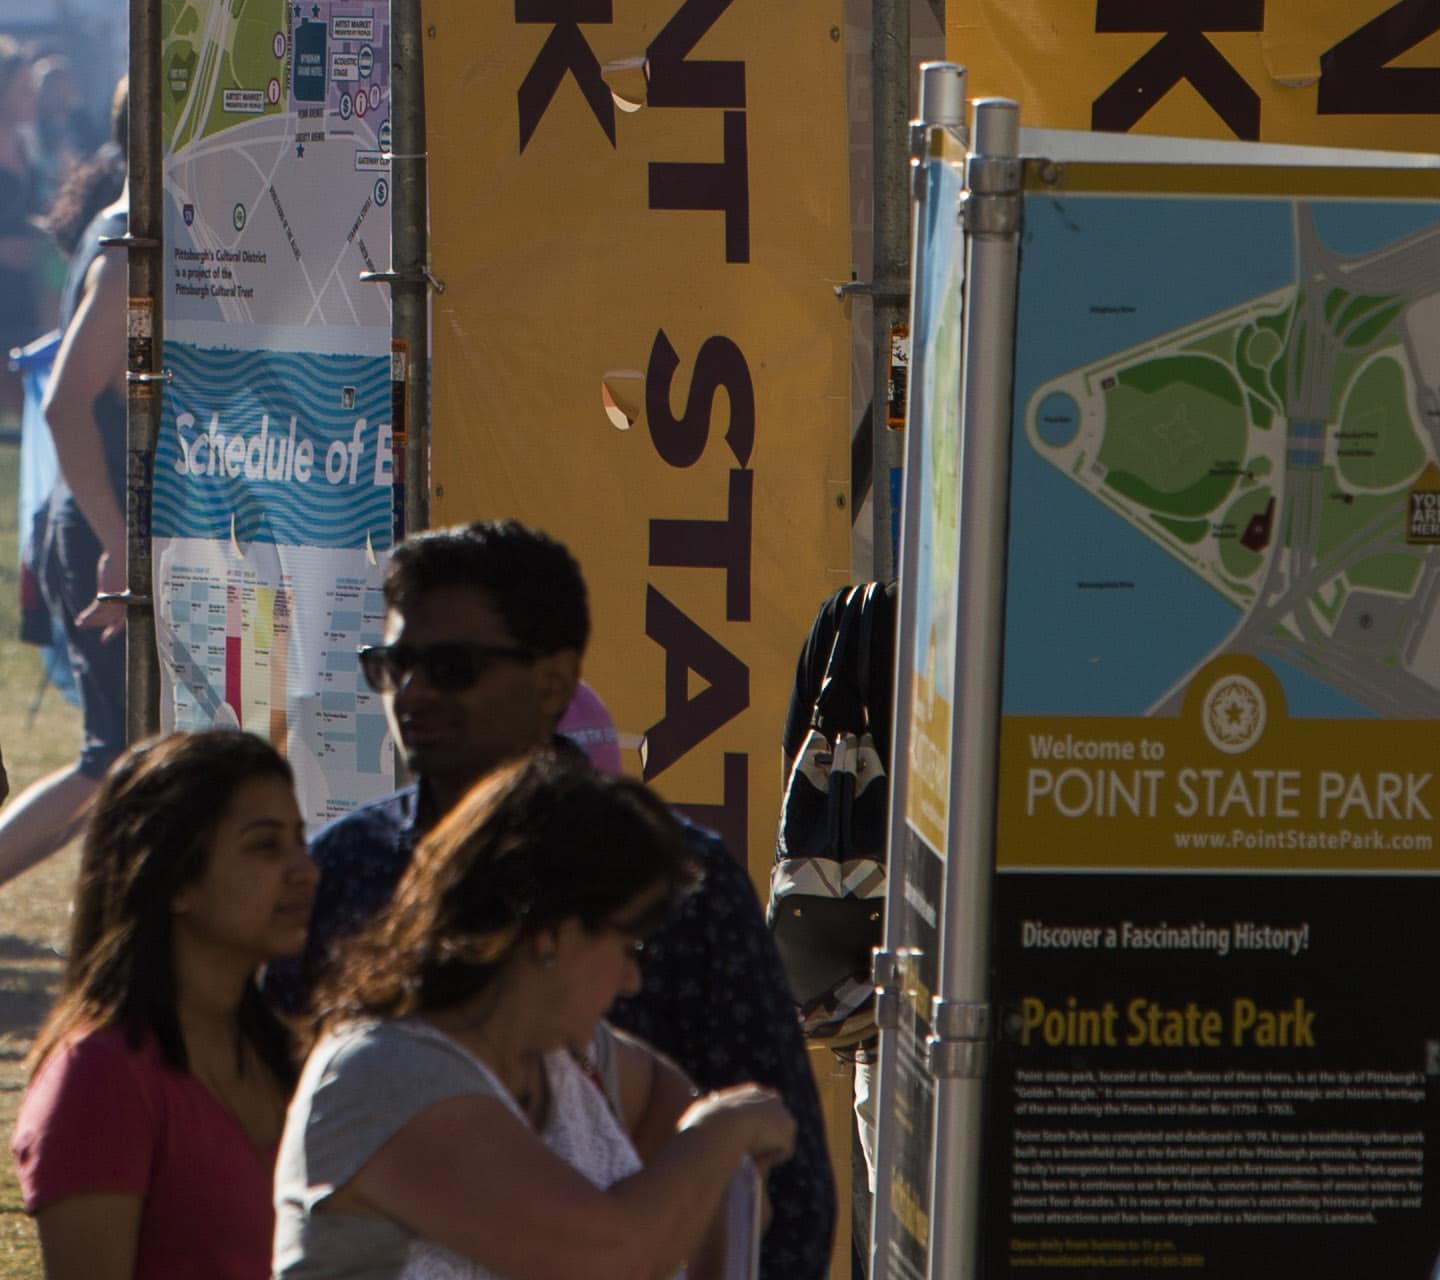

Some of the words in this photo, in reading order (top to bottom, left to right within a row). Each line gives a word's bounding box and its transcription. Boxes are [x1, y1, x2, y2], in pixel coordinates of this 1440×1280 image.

[216, 249, 240, 260] Cultural
[242, 250, 267, 263] District
[212, 268, 221, 279] of
[222, 268, 232, 279] the
[210, 285, 235, 297] Cultural
[237, 286, 254, 298] Trust
[175, 412, 315, 482] Schedule
[325, 418, 367, 485] of
[1029, 735, 1135, 761] Welcome
[1139, 737, 1165, 761] to
[1026, 769, 1166, 817] POINT
[1175, 769, 1301, 819] STATE
[1318, 772, 1434, 821] PARK
[1174, 829, 1433, 850] www.PointStatePark.com
[1022, 921, 1100, 948] Discover
[1105, 928, 1117, 948] a
[1121, 922, 1230, 955] Fascinating
[1234, 922, 1310, 955] History!
[1021, 997, 1119, 1047] Point
[1127, 997, 1224, 1047] State
[1233, 997, 1316, 1047] Park
